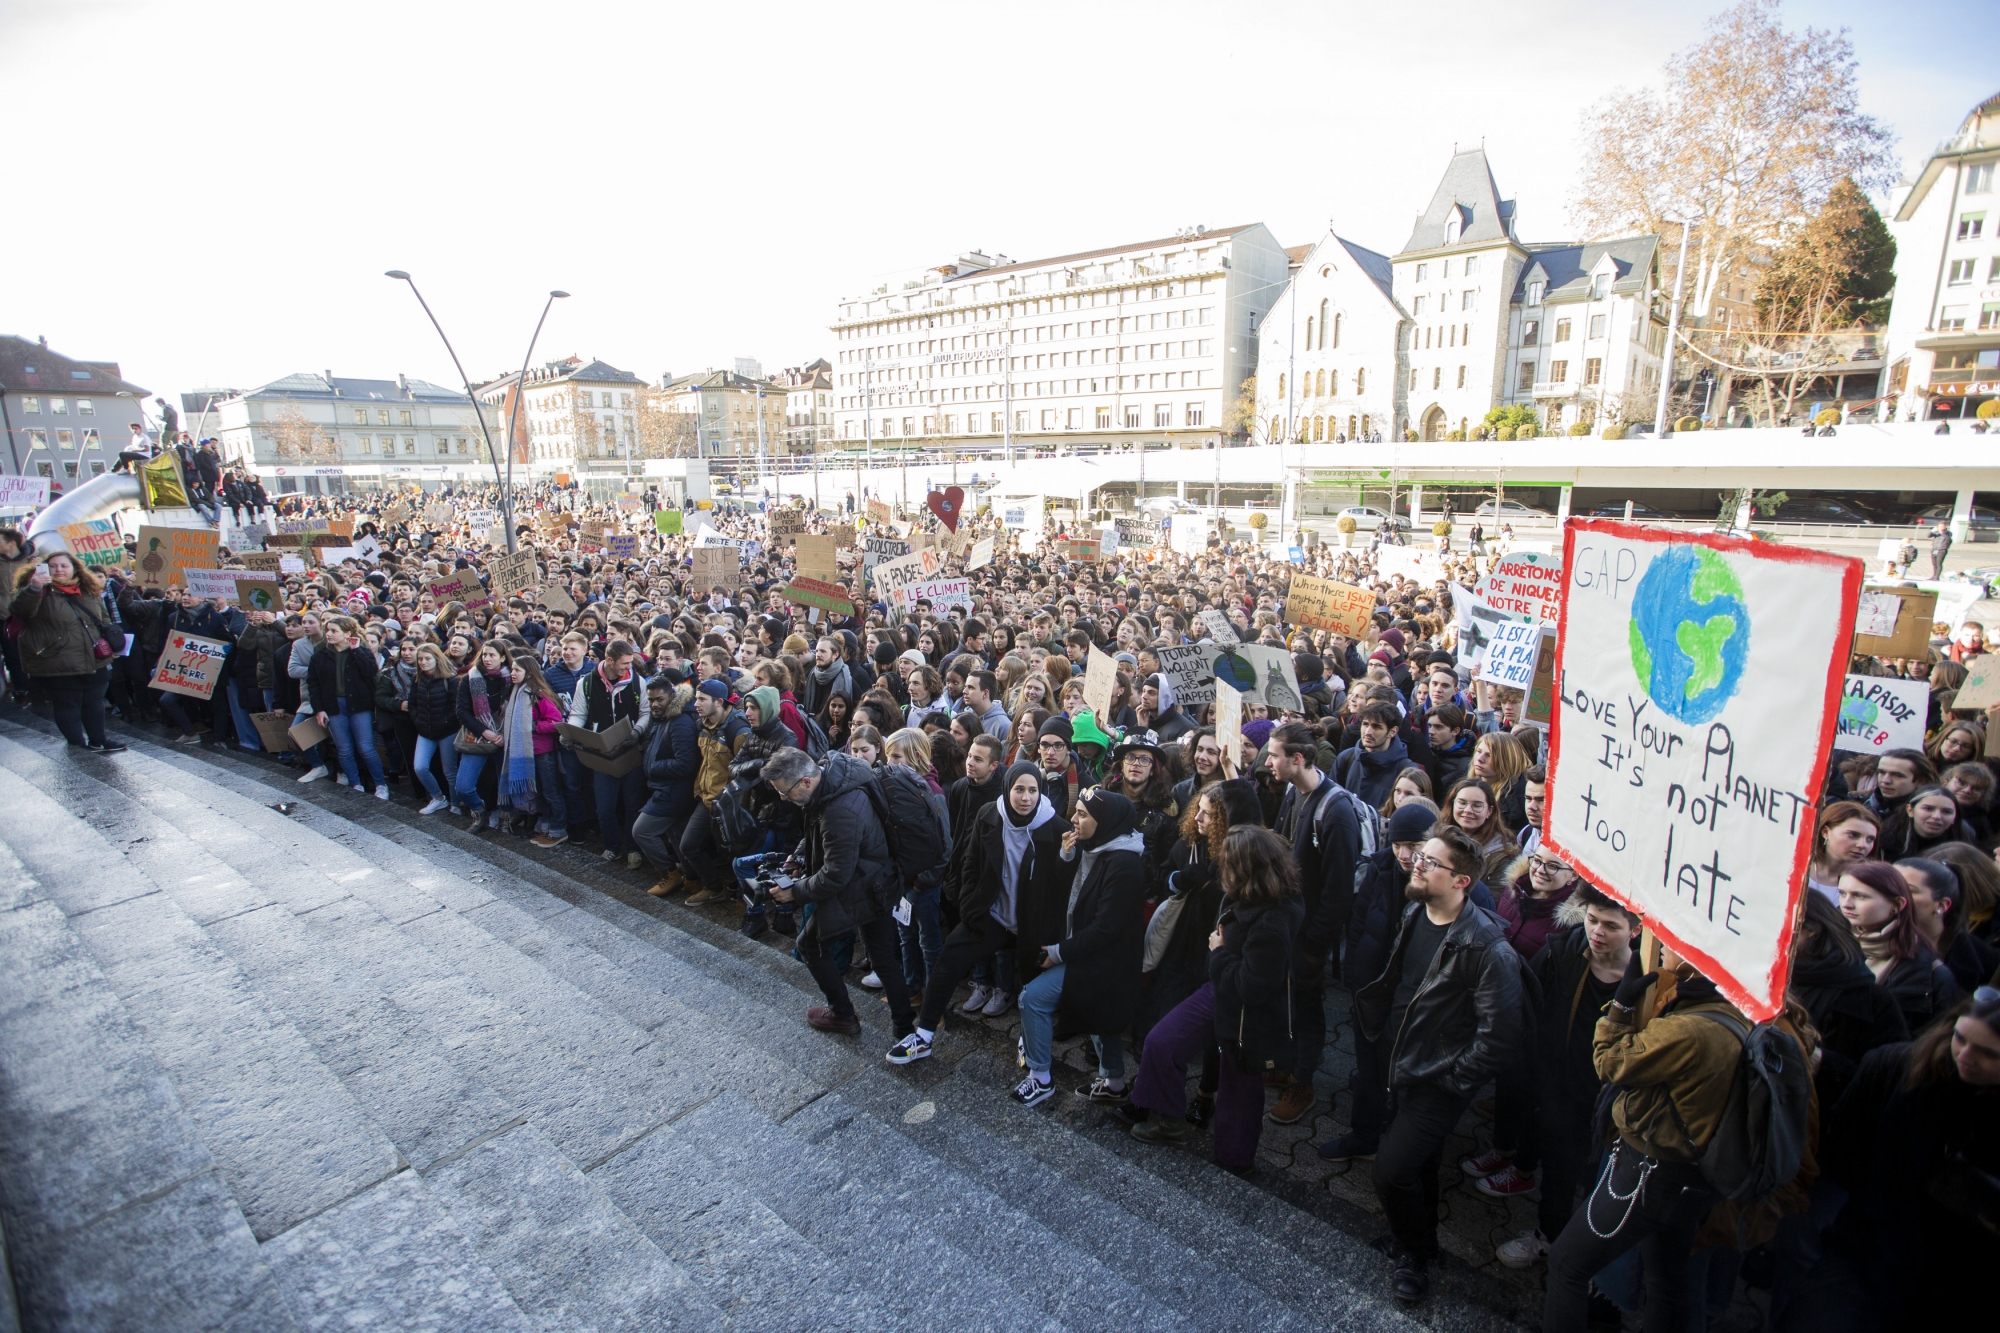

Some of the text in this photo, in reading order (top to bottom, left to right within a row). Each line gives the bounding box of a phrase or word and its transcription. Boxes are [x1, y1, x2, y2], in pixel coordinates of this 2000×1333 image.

[315, 465, 343, 475] métro
[774, 510, 800, 521] DIVEST
[173, 531, 189, 545] ON
[192, 531, 207, 546] EN
[209, 533, 219, 546] A
[173, 545, 210, 559] MARRE
[699, 547, 733, 564] STOP
[248, 556, 279, 566] FONDU
[708, 564, 723, 575] AU
[1498, 561, 1562, 584] ARRÊTONS
[168, 572, 182, 585] DE
[1293, 576, 1319, 591] When
[1489, 577, 1506, 593] DE
[430, 577, 464, 598] Respect
[907, 581, 967, 602] LE CLIMAT
[815, 596, 830, 607] DES
[831, 601, 853, 614] LOIS
[936, 593, 968, 604] CHANGE
[1487, 595, 1532, 615] NOTRE
[1333, 599, 1369, 616] LEFT
[1298, 613, 1350, 635] DOLLARS
[1493, 623, 1506, 640] IL
[1506, 626, 1527, 642] EST
[184, 640, 198, 652] de
[1158, 645, 1202, 662] TOTORO
[1490, 643, 1507, 659] LA
[164, 659, 176, 671] La
[1486, 660, 1504, 678] SE
[1180, 670, 1199, 682] LET
[1172, 679, 1199, 693] THIS
[1850, 679, 1864, 698] A
[1175, 688, 1217, 704] HAPPEN
[1836, 718, 1889, 746] NETE B
[1667, 781, 1728, 832] not
[1580, 783, 1627, 852] too
